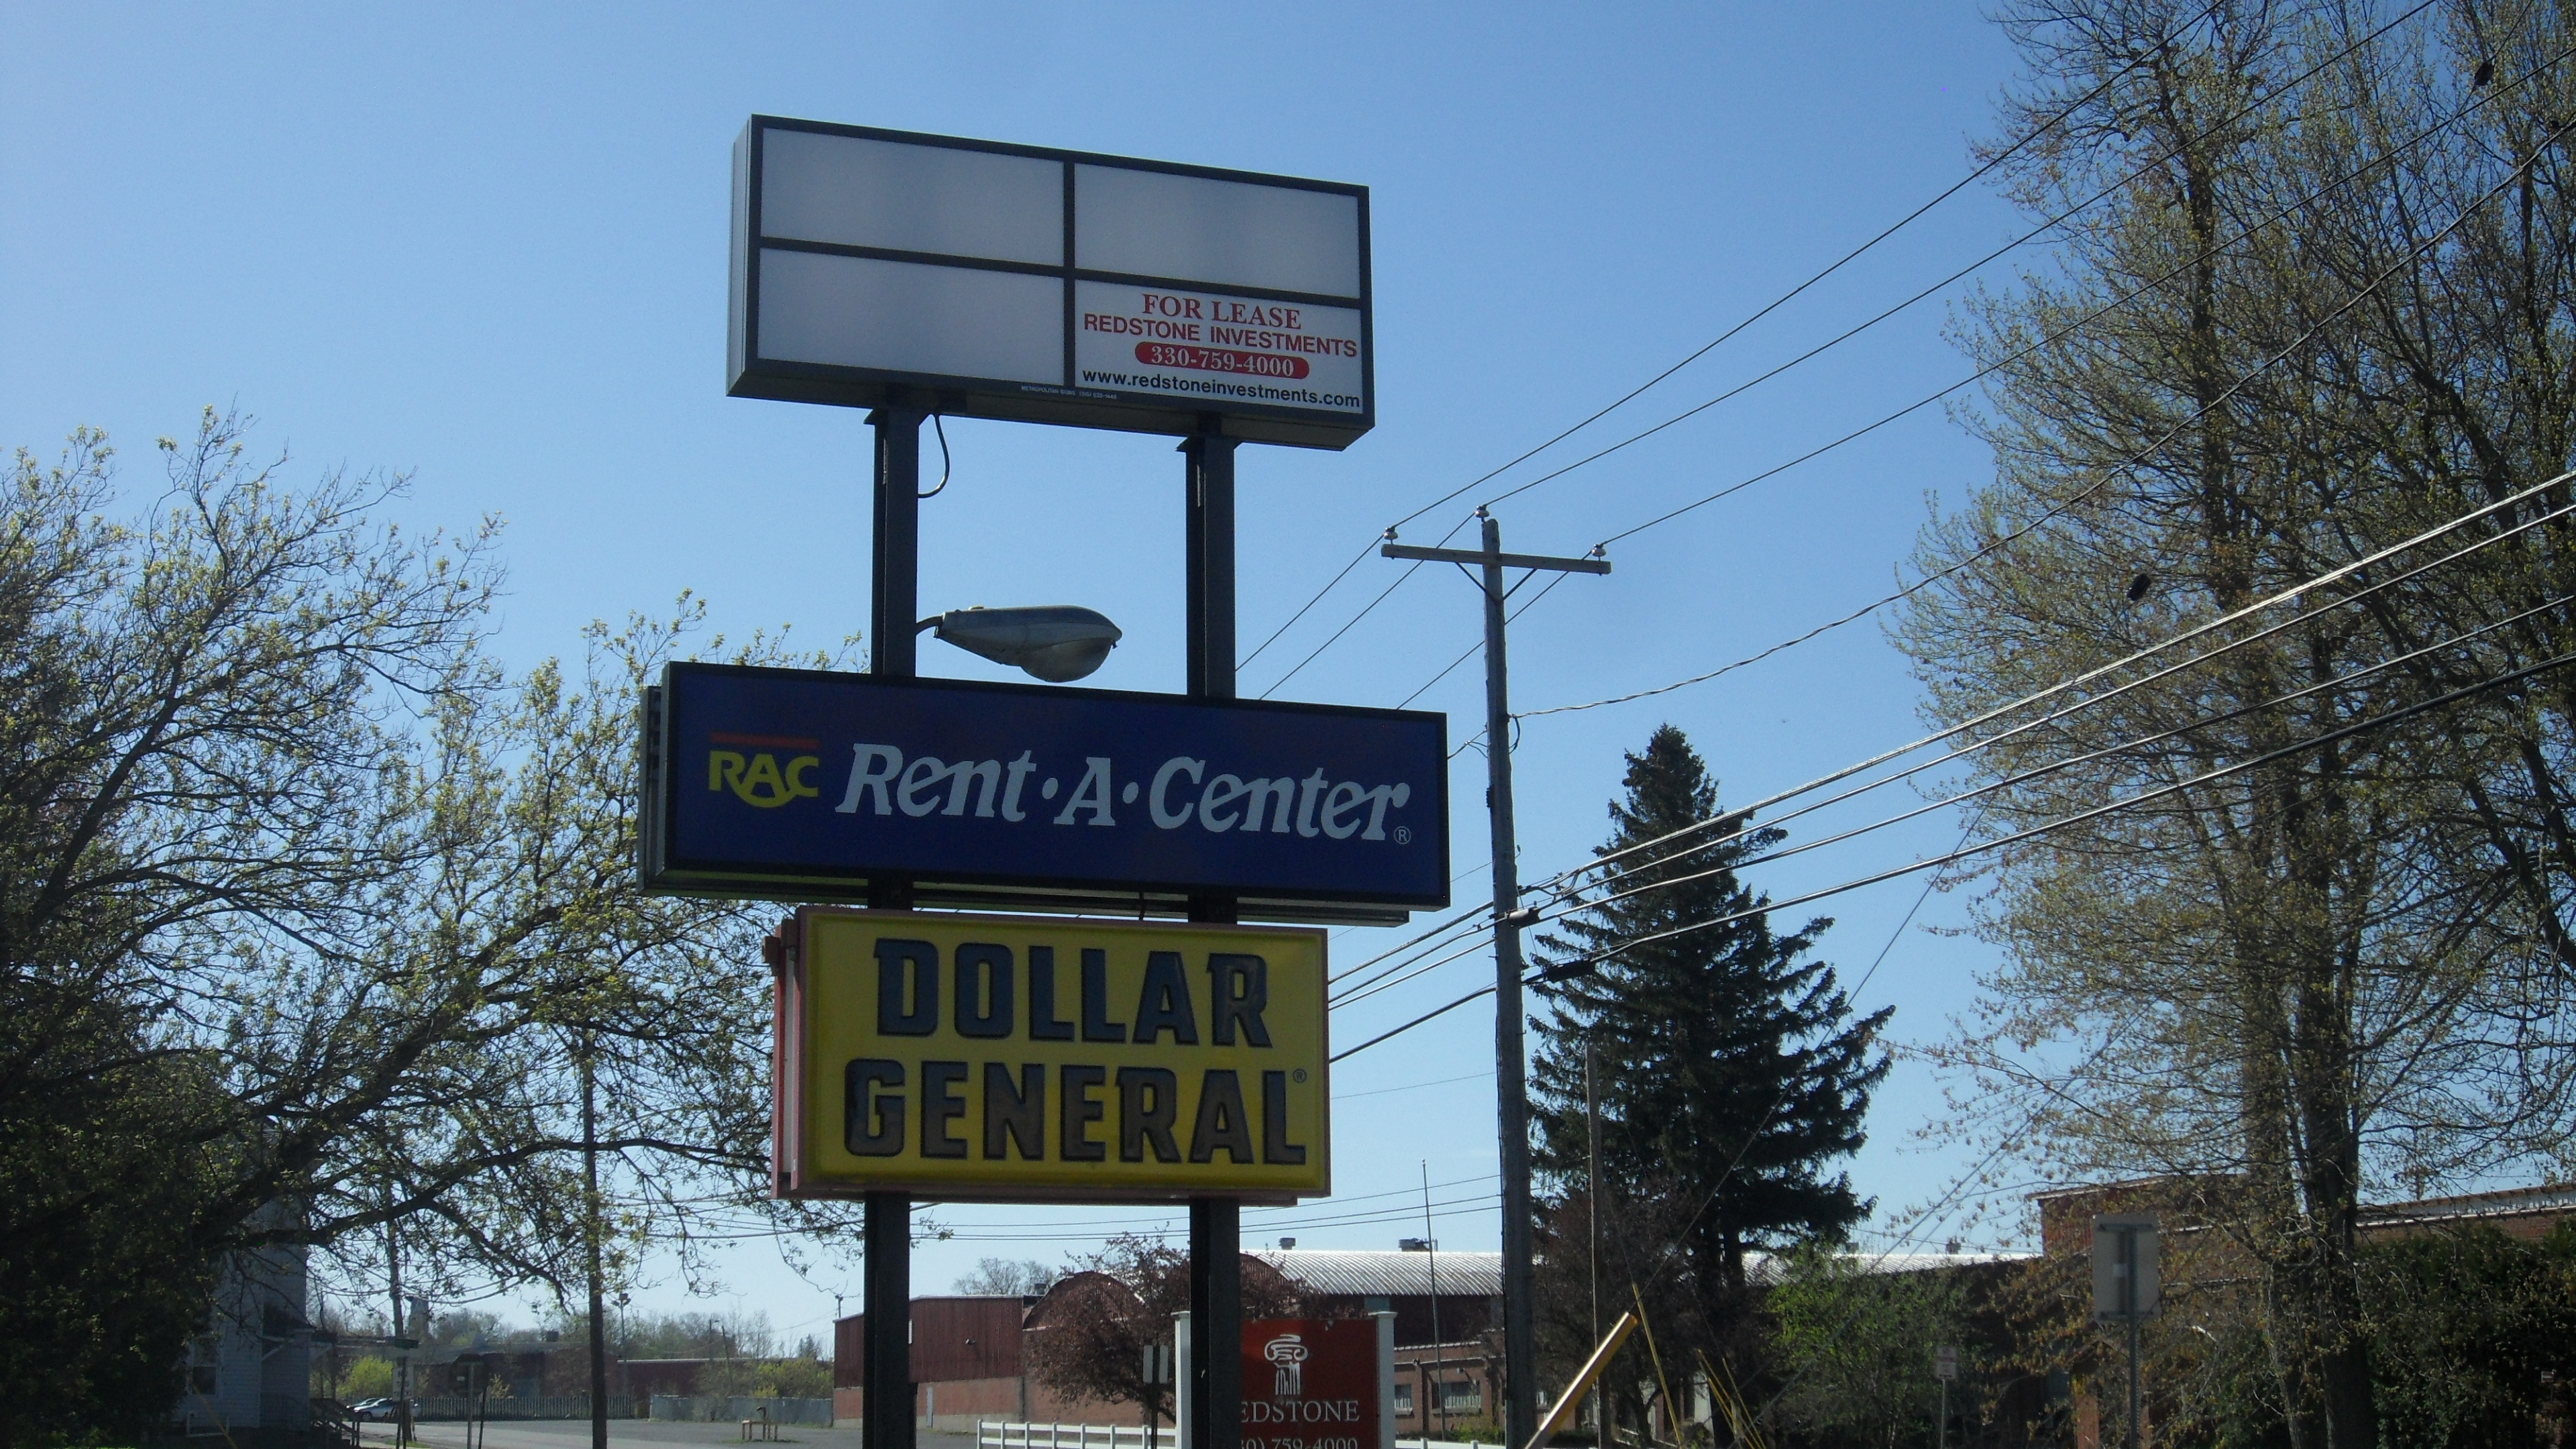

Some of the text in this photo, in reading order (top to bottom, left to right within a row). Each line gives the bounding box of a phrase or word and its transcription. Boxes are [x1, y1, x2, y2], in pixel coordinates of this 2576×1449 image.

[1142, 293, 1302, 330] FOR LEASE
[1084, 313, 1357, 358] REDSTONE INVESTMENTS
[1151, 345, 1295, 378] 330-759-4000
[1082, 369, 1360, 408] www.redstoneinvestments.com
[707, 749, 820, 807] RAC
[873, 938, 1273, 1049] DOLLAR
[843, 1058, 1307, 1166] GENERAL
[1241, 1399, 1360, 1423] EDSTONE
